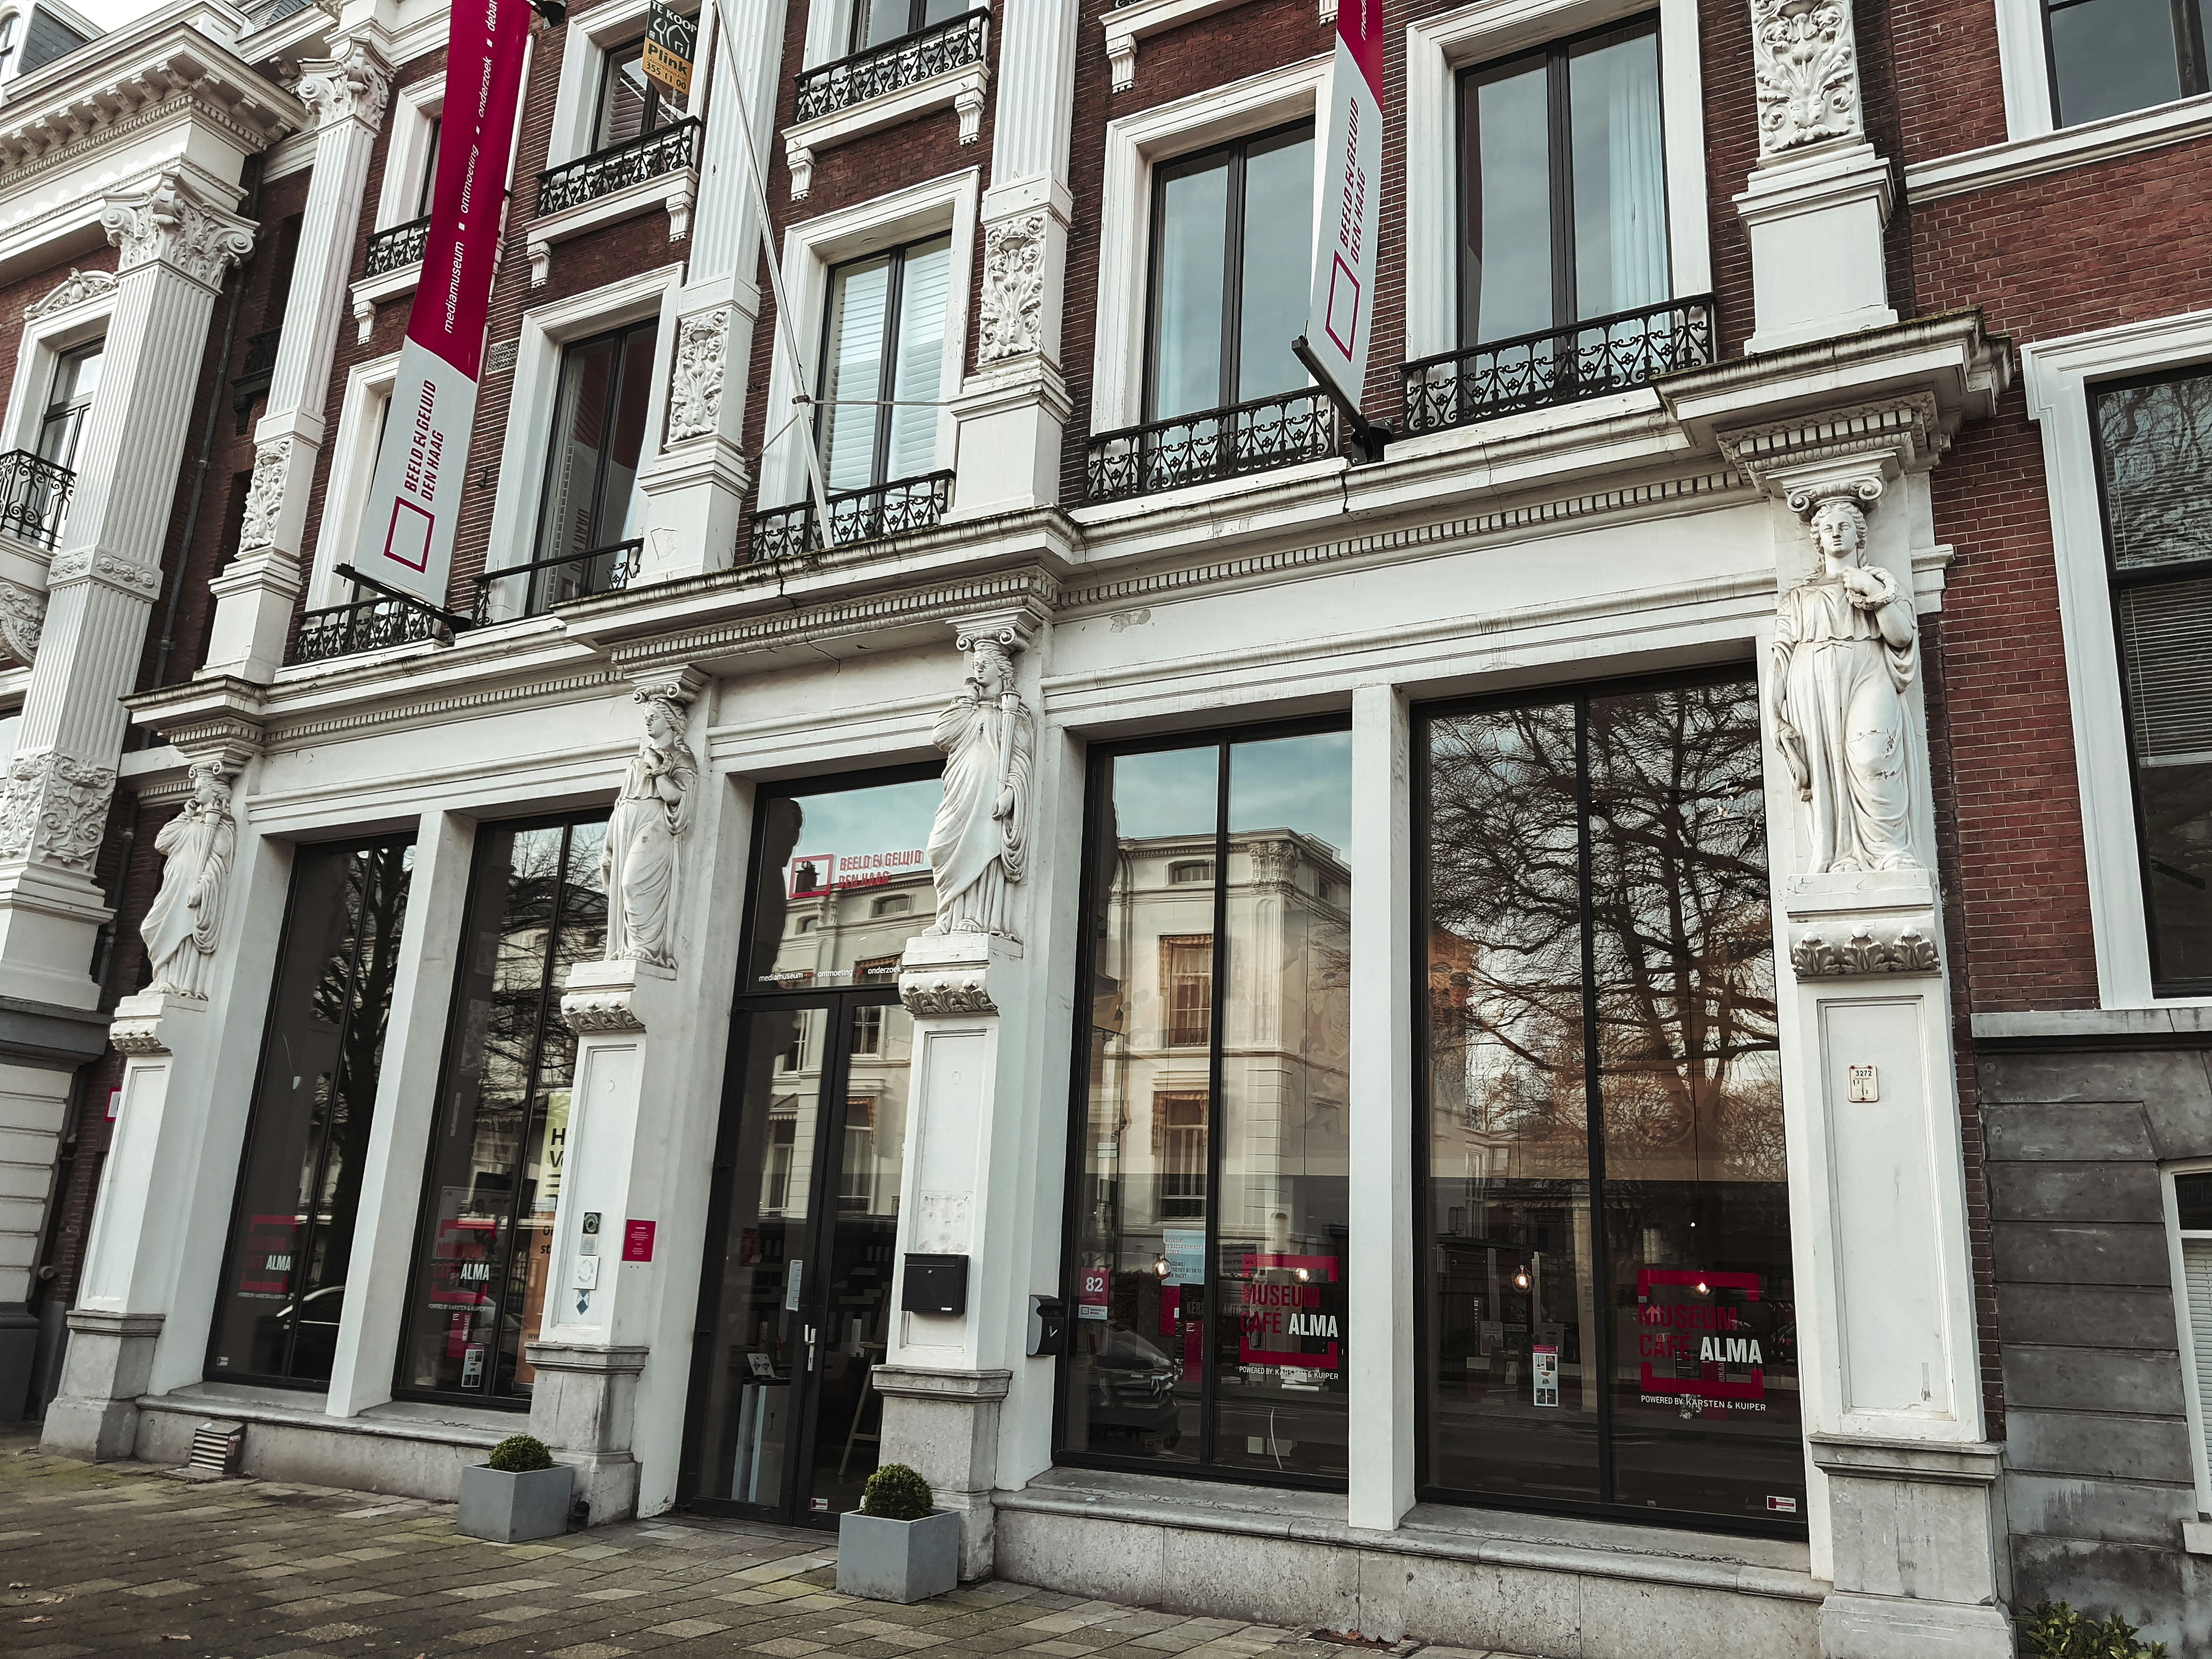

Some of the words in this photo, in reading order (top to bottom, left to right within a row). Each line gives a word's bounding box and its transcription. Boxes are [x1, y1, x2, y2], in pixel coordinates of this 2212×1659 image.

[652, 1, 663, 14] TE
[666, 9, 697, 33] KOOP
[648, 43, 687, 75] Plink
[646, 61, 661, 75] 355
[676, 80, 686, 89] 00
[1347, 97, 1359, 167] GELUID
[1345, 163, 1355, 189] EN
[444, 241, 464, 334] mediamuseum
[461, 144, 479, 213] ontmoeting
[478, 56, 492, 118] onderzoek
[1353, 166, 1365, 223] HAAG
[1340, 186, 1353, 250] BEELD
[1350, 219, 1362, 265] DEN
[416, 380, 436, 431] GELUID
[413, 430, 427, 448] EN
[426, 430, 444, 470] HAAG
[404, 447, 424, 493] BEELD
[420, 470, 437, 502] DEN
[840, 855, 871, 871] BEELD
[872, 854, 883, 867] EN
[885, 850, 922, 867] GELUID
[838, 873, 859, 888] DEN
[861, 871, 890, 887] HAAG
[759, 972, 803, 982] mediamuseum
[817, 968, 853, 978] ontmoeting
[868, 966, 901, 974] onderzoek
[550, 1150, 563, 1168] V
[266, 1254, 291, 1271] ALMA
[460, 1263, 489, 1280] ALMA
[1086, 1277, 1103, 1292] 82
[1242, 1284, 1320, 1308] MUSEUM
[1240, 1307, 1282, 1334] CAFÉ
[1288, 1313, 1339, 1338] ALMA
[1638, 1302, 1738, 1331] MUSEUM
[1639, 1331, 1692, 1359] CAFÉ
[1700, 1336, 1763, 1364] ALMA
[1239, 1365, 1265, 1374] POWERED
[1641, 1395, 1673, 1404] POWERED
[1686, 1398, 1725, 1408] KARSTEN
[1735, 1402, 1766, 1412] KUIPER
